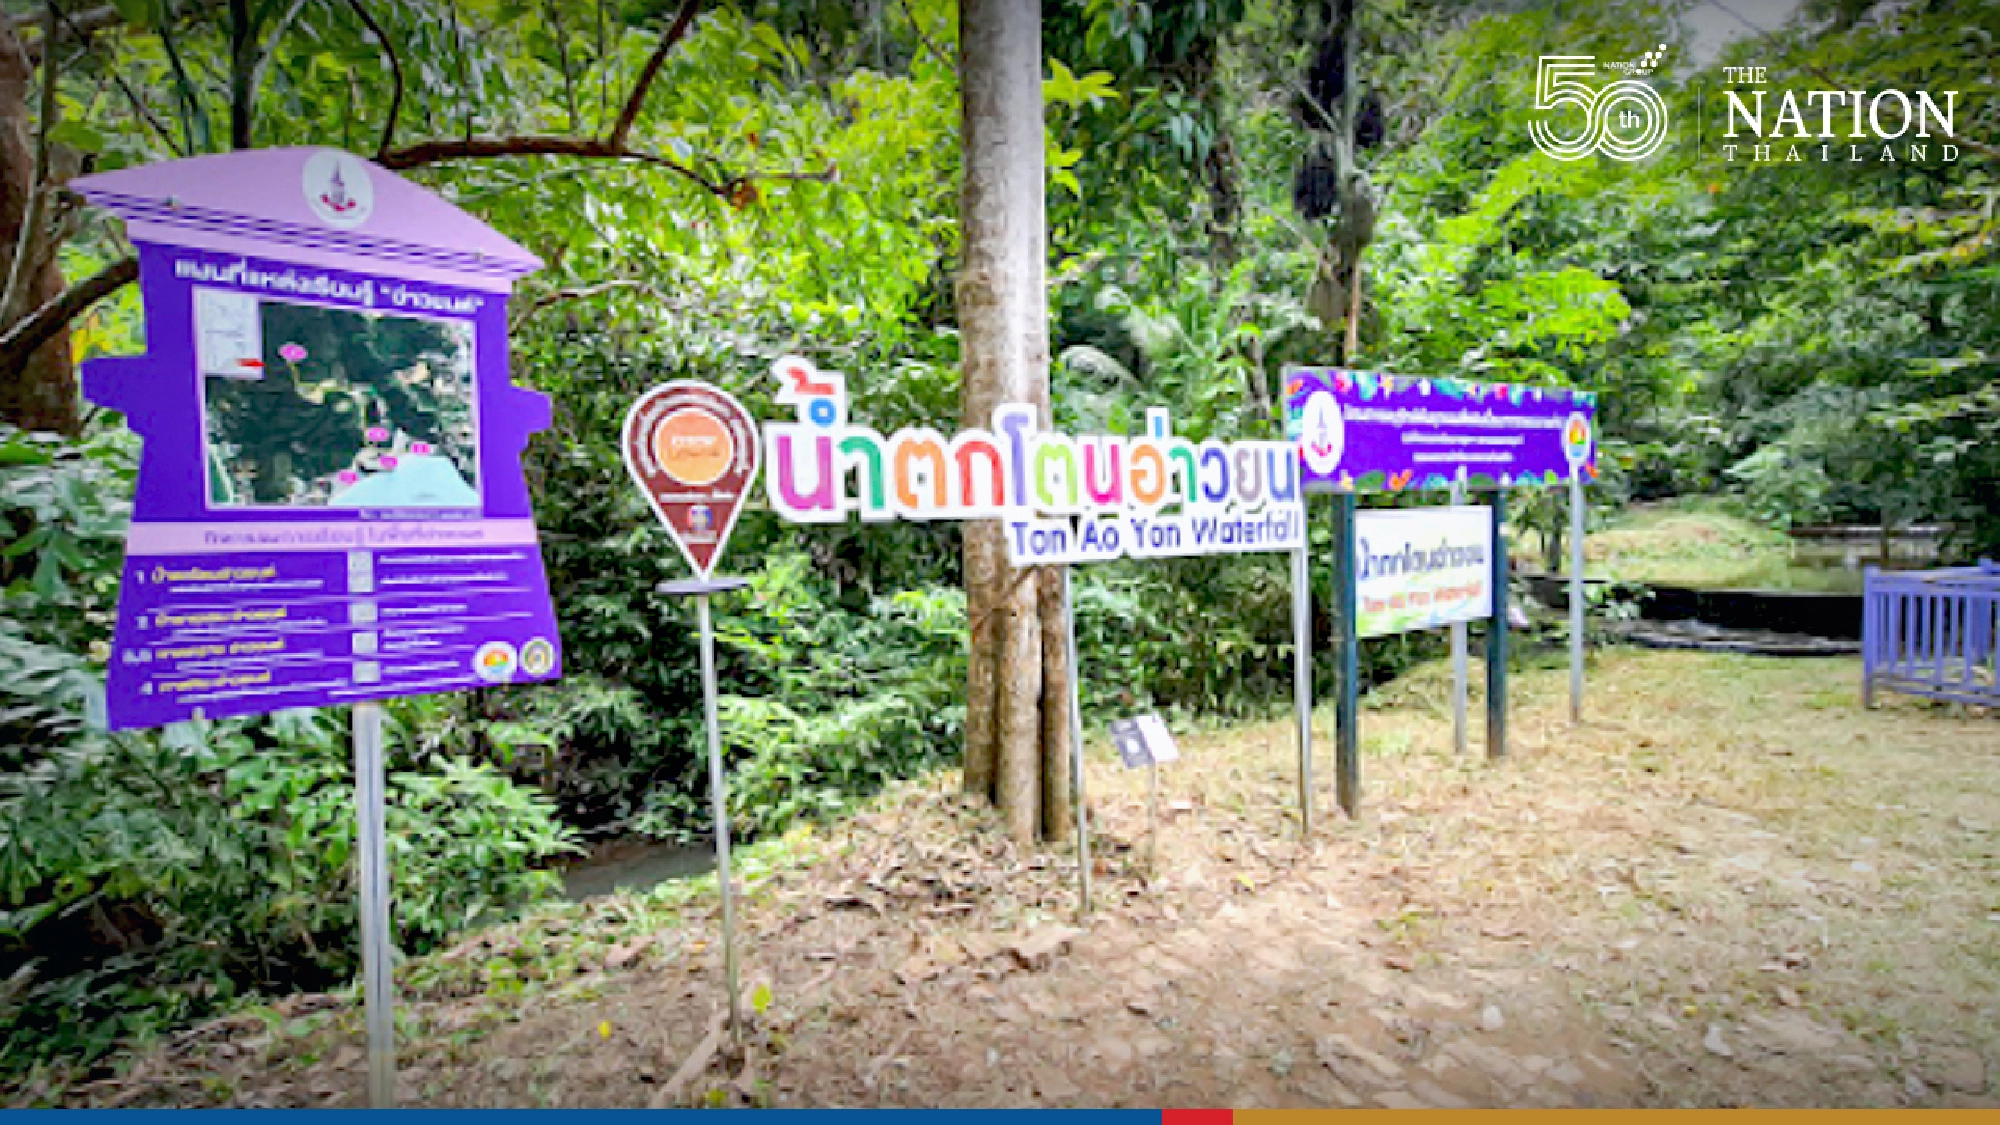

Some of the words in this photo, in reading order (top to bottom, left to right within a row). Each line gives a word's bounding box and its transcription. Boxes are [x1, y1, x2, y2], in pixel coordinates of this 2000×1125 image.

[776, 365, 1296, 510] น้ำตกโตนอ่าวยน
[1011, 521, 1067, 556] Ton
[1080, 519, 1120, 552] Ao
[1130, 517, 1182, 549] Yon
